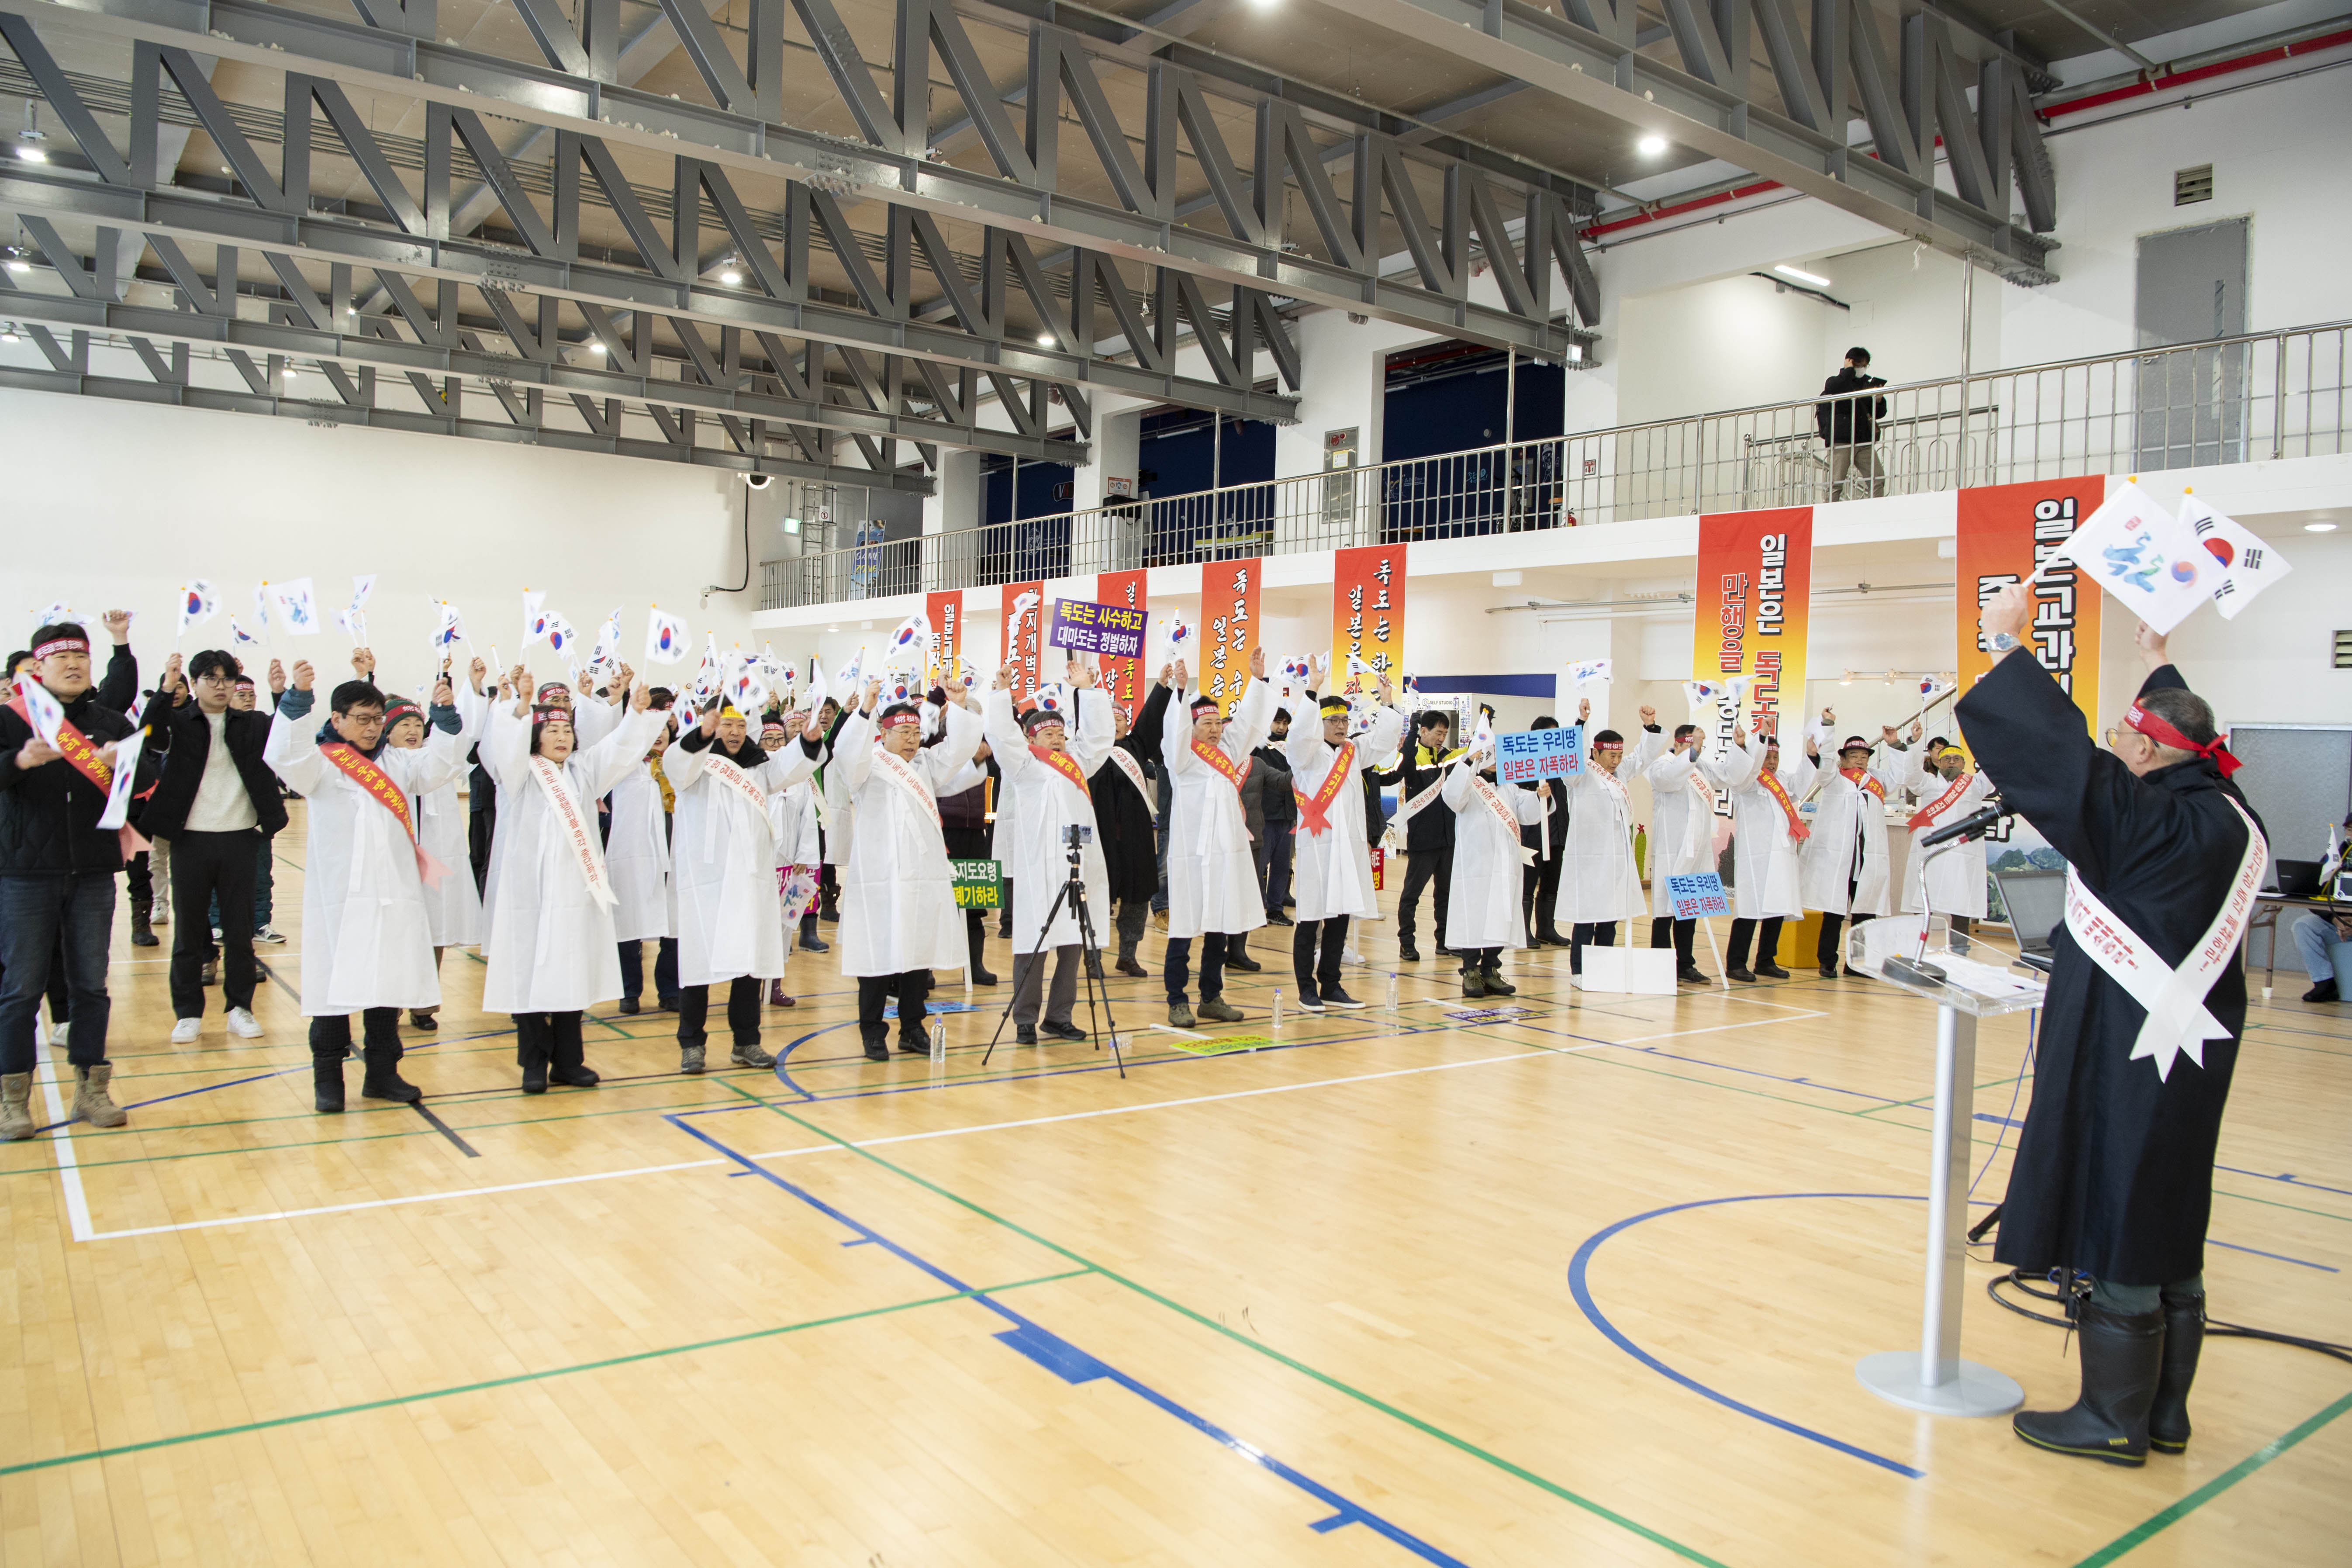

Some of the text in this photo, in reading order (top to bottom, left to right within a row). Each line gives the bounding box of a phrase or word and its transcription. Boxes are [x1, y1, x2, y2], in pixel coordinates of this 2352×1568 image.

[1755, 532, 1788, 635] 일본은
[1230, 567, 1248, 652] 독도는
[1371, 559, 1392, 642] 독도는
[1059, 601, 1143, 632] 독도는 사수하고
[1717, 572, 1749, 673] 만행을
[1057, 626, 1139, 656] 대마도는 정벌하자
[1209, 615, 1228, 698] 일본은
[1122, 659, 1135, 700] 독도
[1502, 728, 1576, 756] 독도는 우리땅
[1502, 752, 1579, 781] 일본은 자폭하라
[1320, 772, 1340, 803] 지키자!
[955, 885, 998, 907] 폐기하라
[1670, 875, 1720, 895] 독도는 우리땅
[1675, 895, 1726, 917] 일본은 자폭하라
